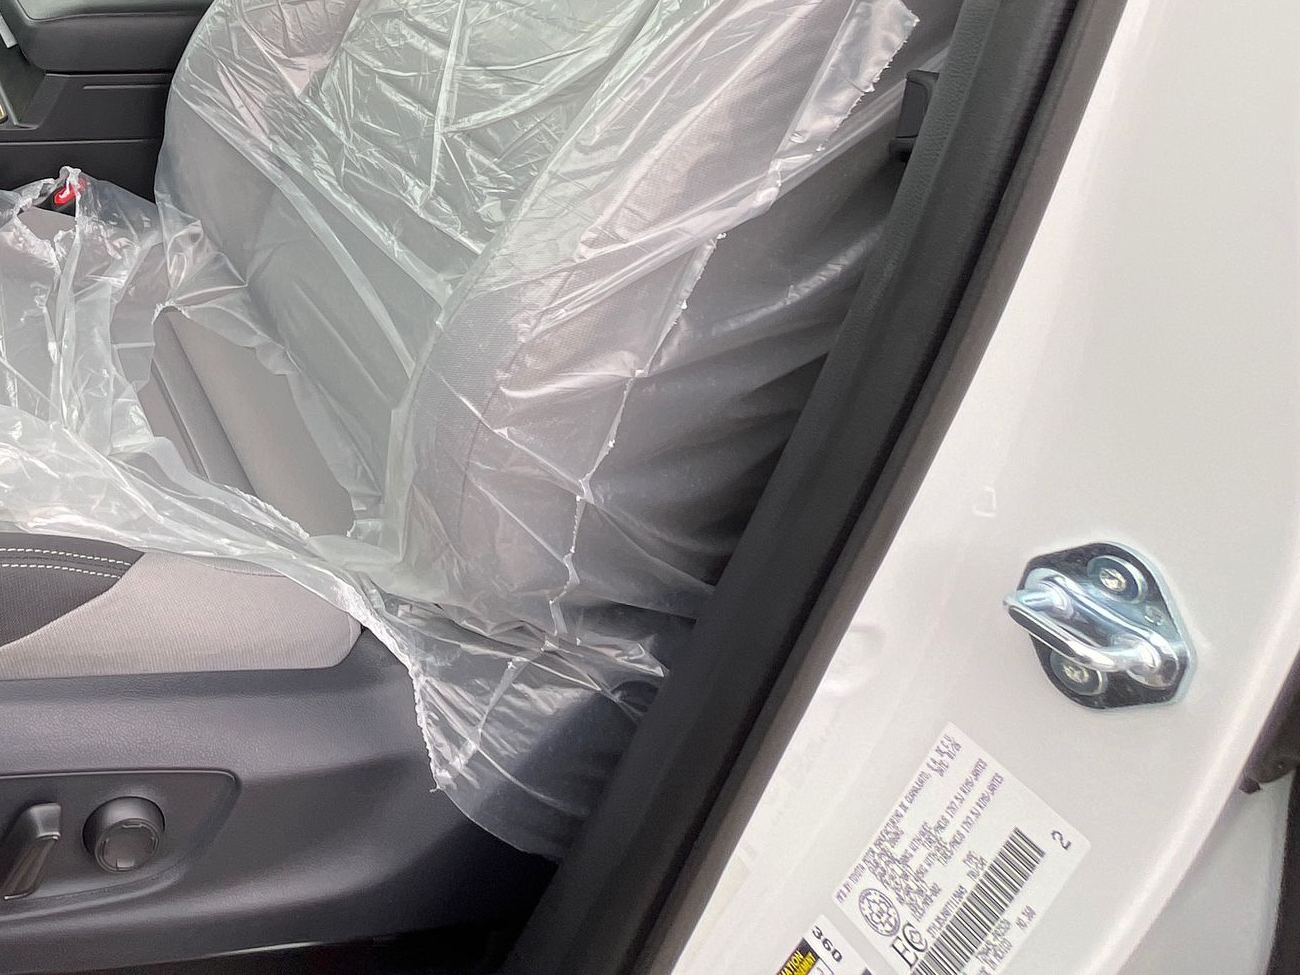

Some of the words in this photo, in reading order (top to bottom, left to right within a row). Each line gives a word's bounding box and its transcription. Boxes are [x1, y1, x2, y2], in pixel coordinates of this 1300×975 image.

[848, 862, 866, 883] TOYOTA
[861, 846, 877, 866] MOTOR
[872, 808, 903, 850] MANUFACTURING
[1051, 829, 1073, 852] 2
[811, 925, 844, 963] 360
